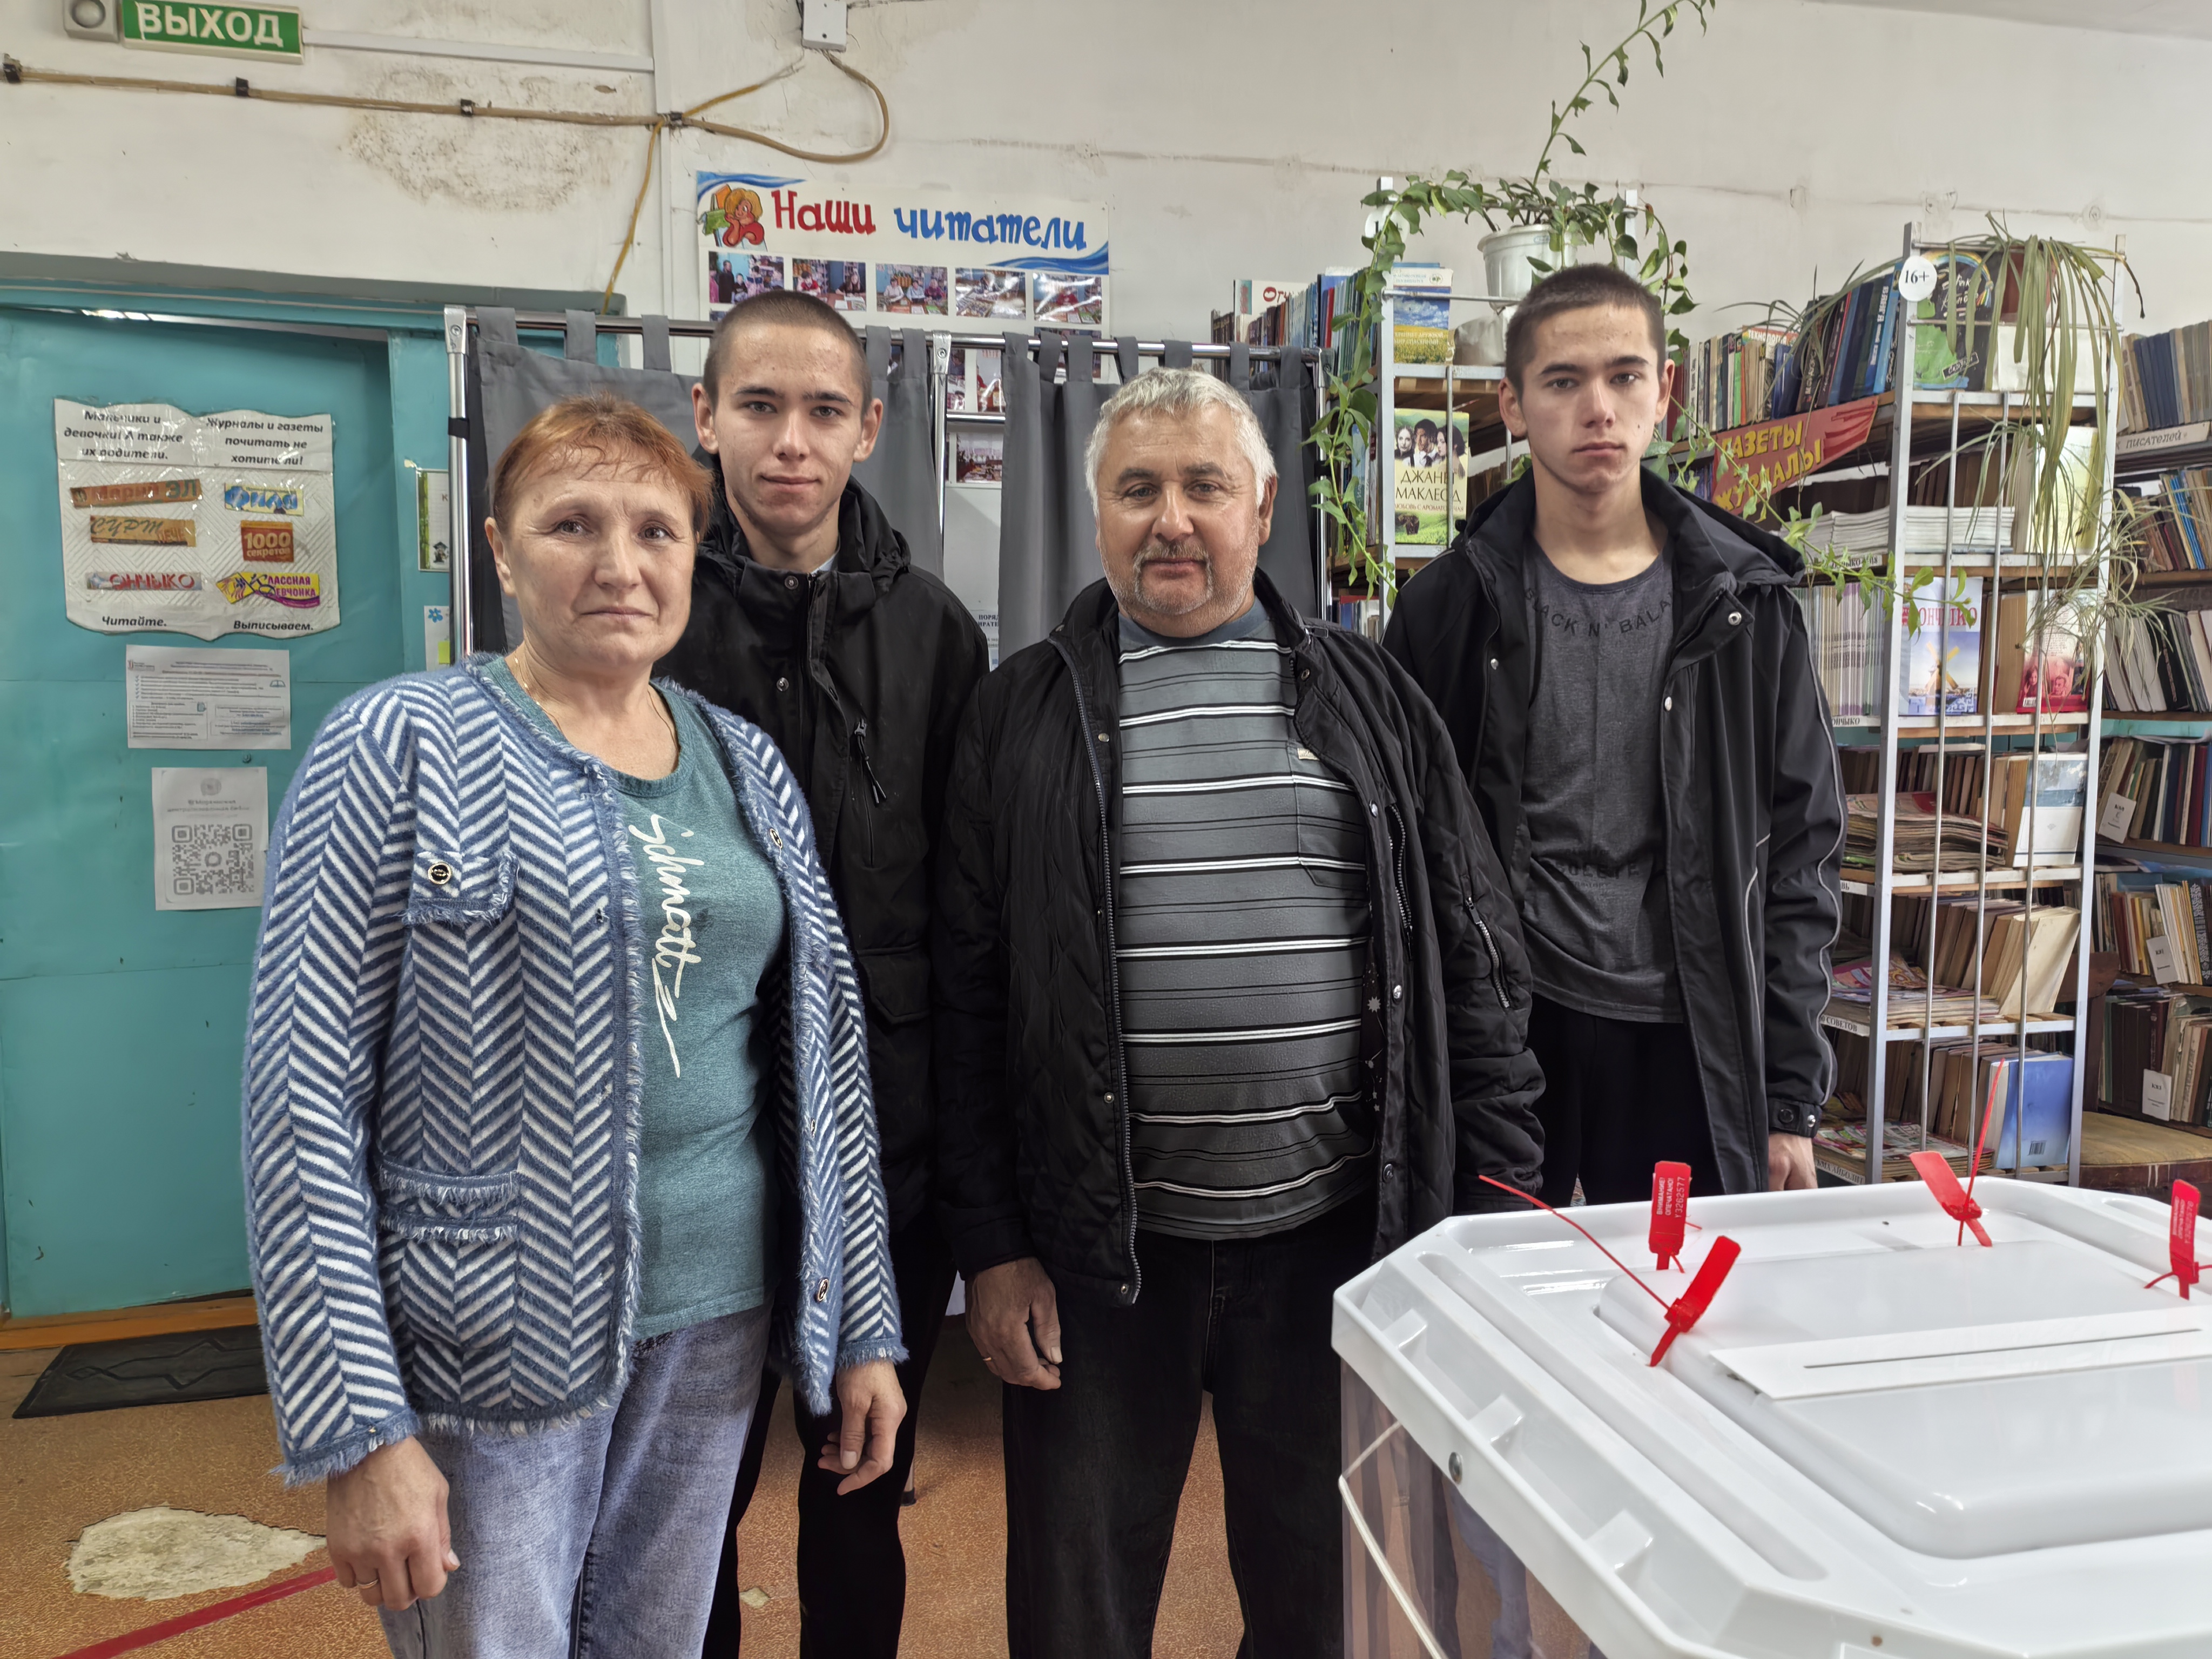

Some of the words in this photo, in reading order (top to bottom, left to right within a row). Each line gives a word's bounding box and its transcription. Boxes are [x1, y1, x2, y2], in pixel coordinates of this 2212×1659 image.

[141, 3, 284, 48] ВЫХОД
[771, 189, 876, 235] Наши
[894, 206, 1087, 252] читатели
[1905, 269, 1930, 284] 16+
[206, 417, 264, 430] Журналы
[267, 422, 274, 430] и
[276, 423, 323, 433] газеты
[137, 434, 183, 442] также
[225, 437, 291, 448] почитать
[293, 441, 307, 449] не
[244, 532, 291, 549] 1000
[102, 615, 167, 628] Читайте.
[1619, 598, 1671, 635] BALA
[233, 621, 314, 631] Выписываем.
